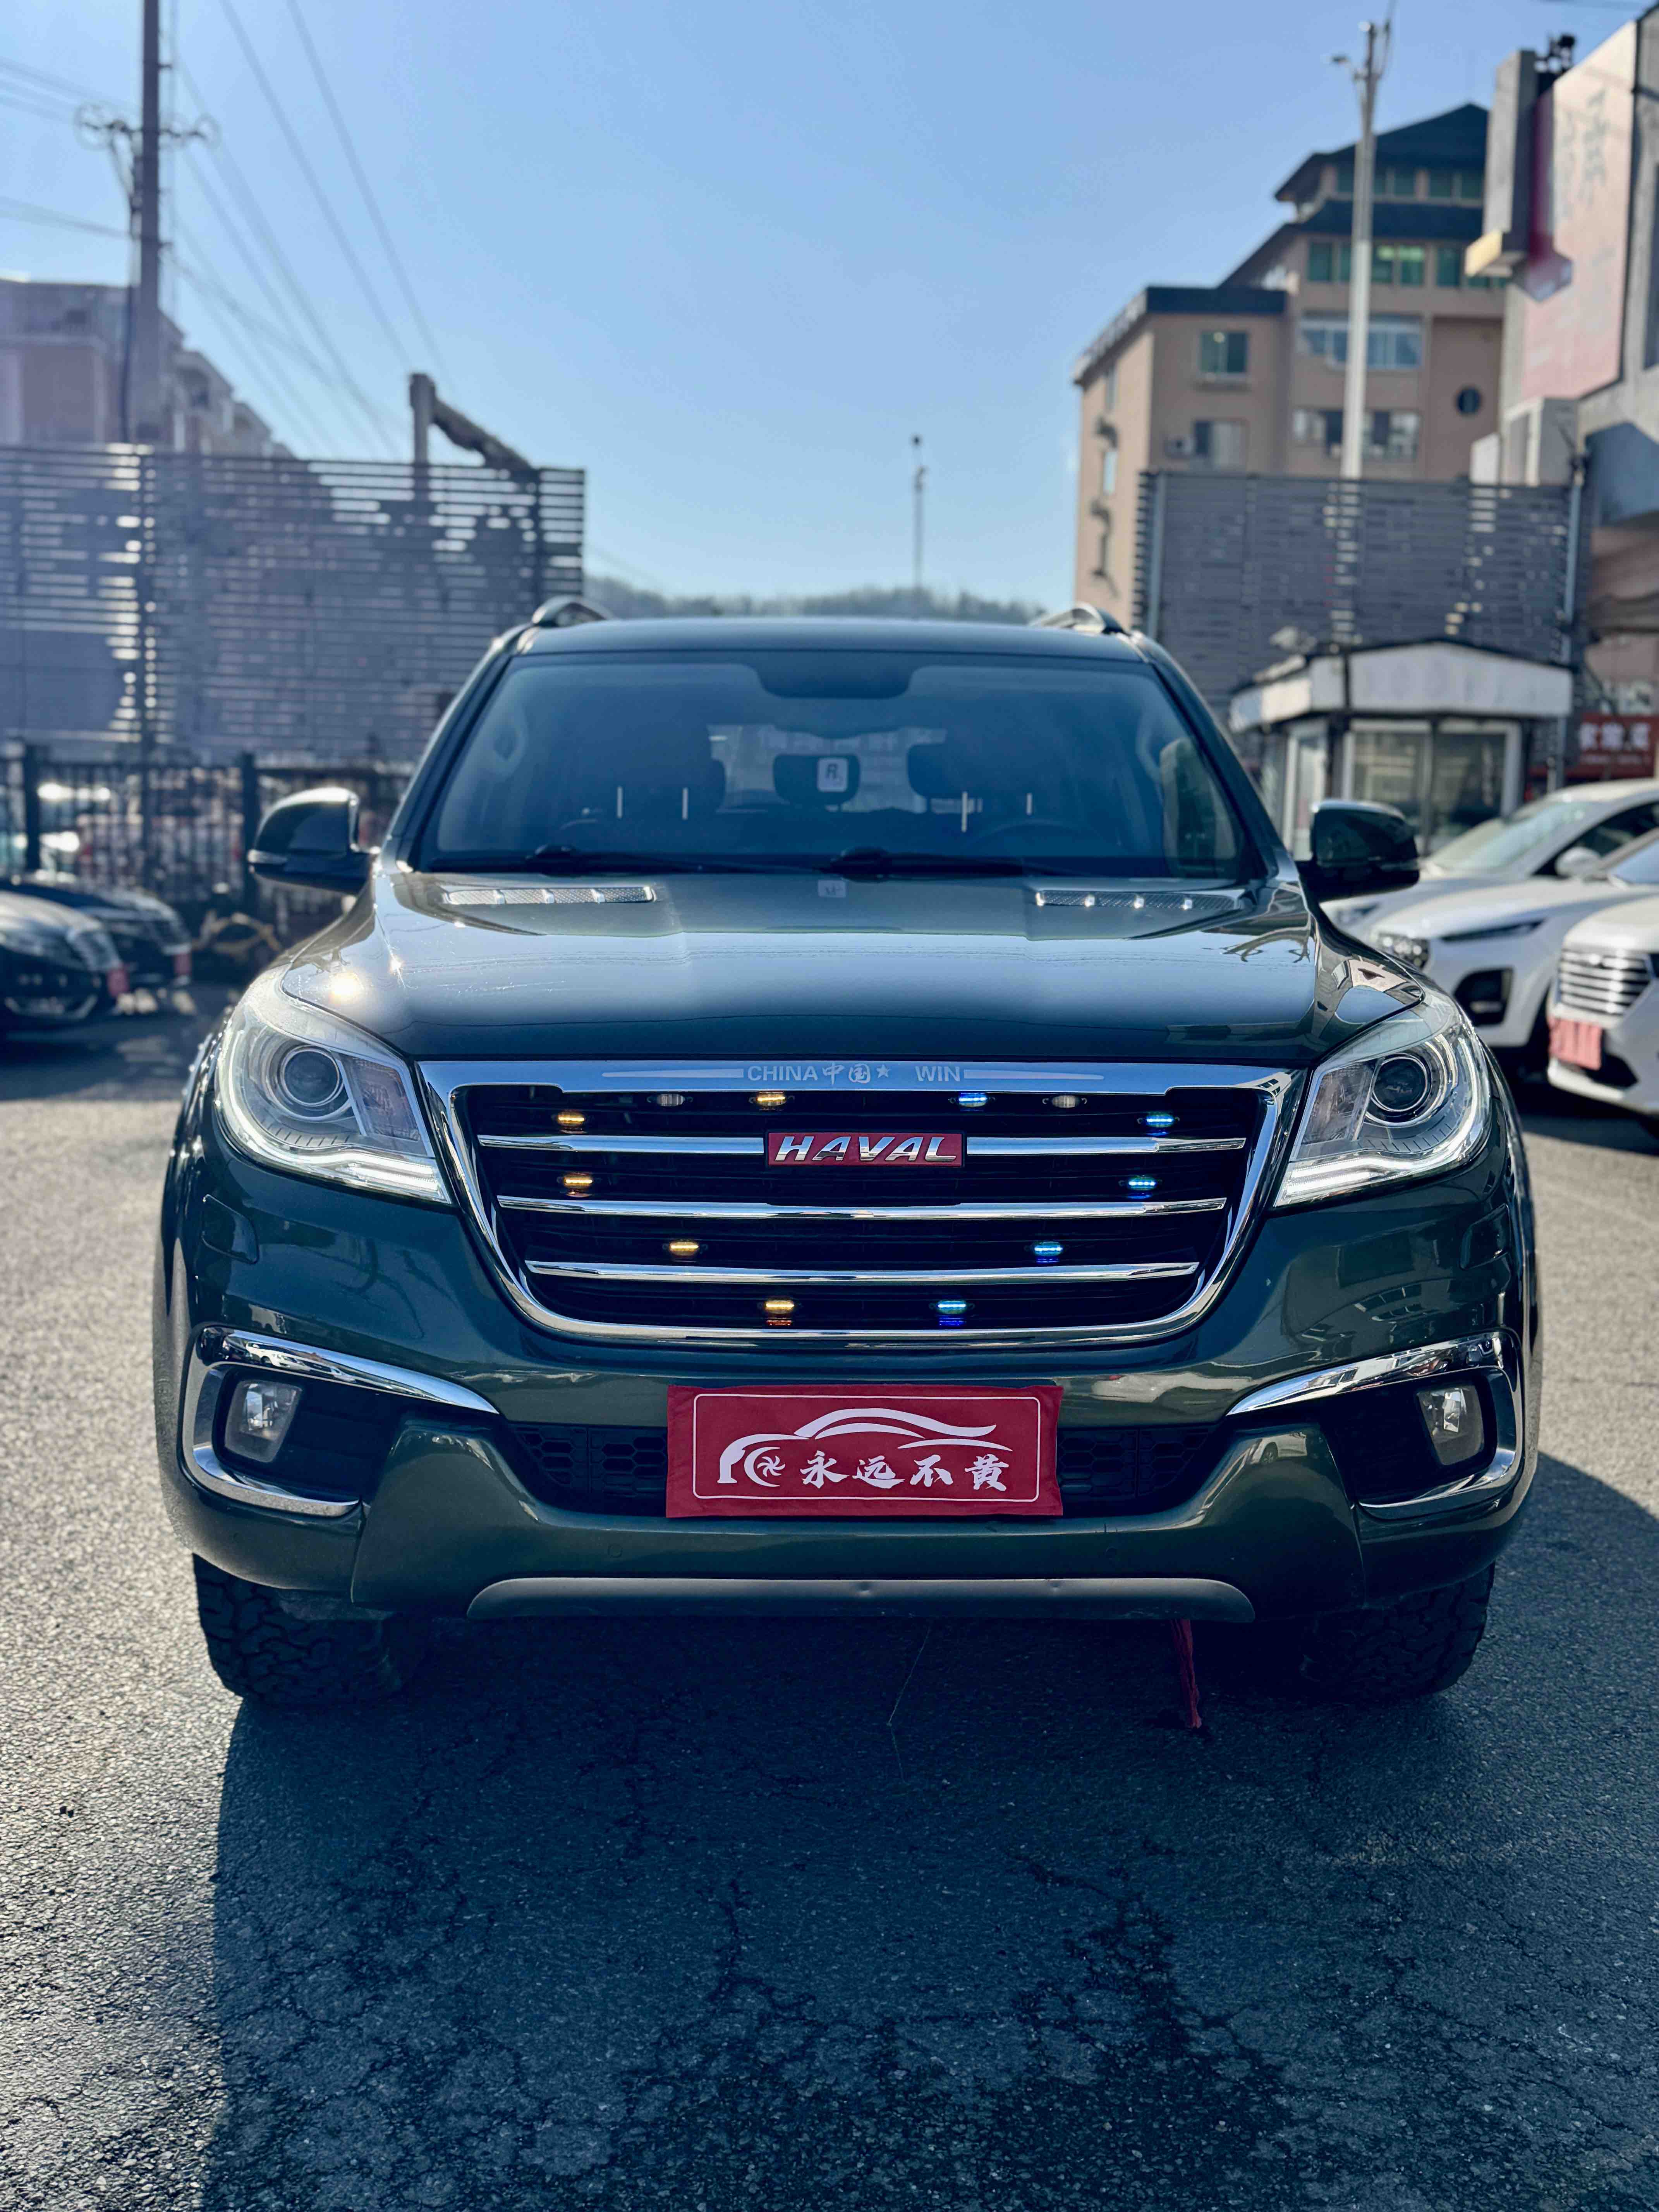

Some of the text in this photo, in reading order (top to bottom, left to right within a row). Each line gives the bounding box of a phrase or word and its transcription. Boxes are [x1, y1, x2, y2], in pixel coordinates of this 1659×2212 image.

[747, 1061, 960, 1085] CHINA 中国 WIN
[775, 1136, 957, 1161] HAVAL
[800, 1450, 1009, 1491] 永远不黄
